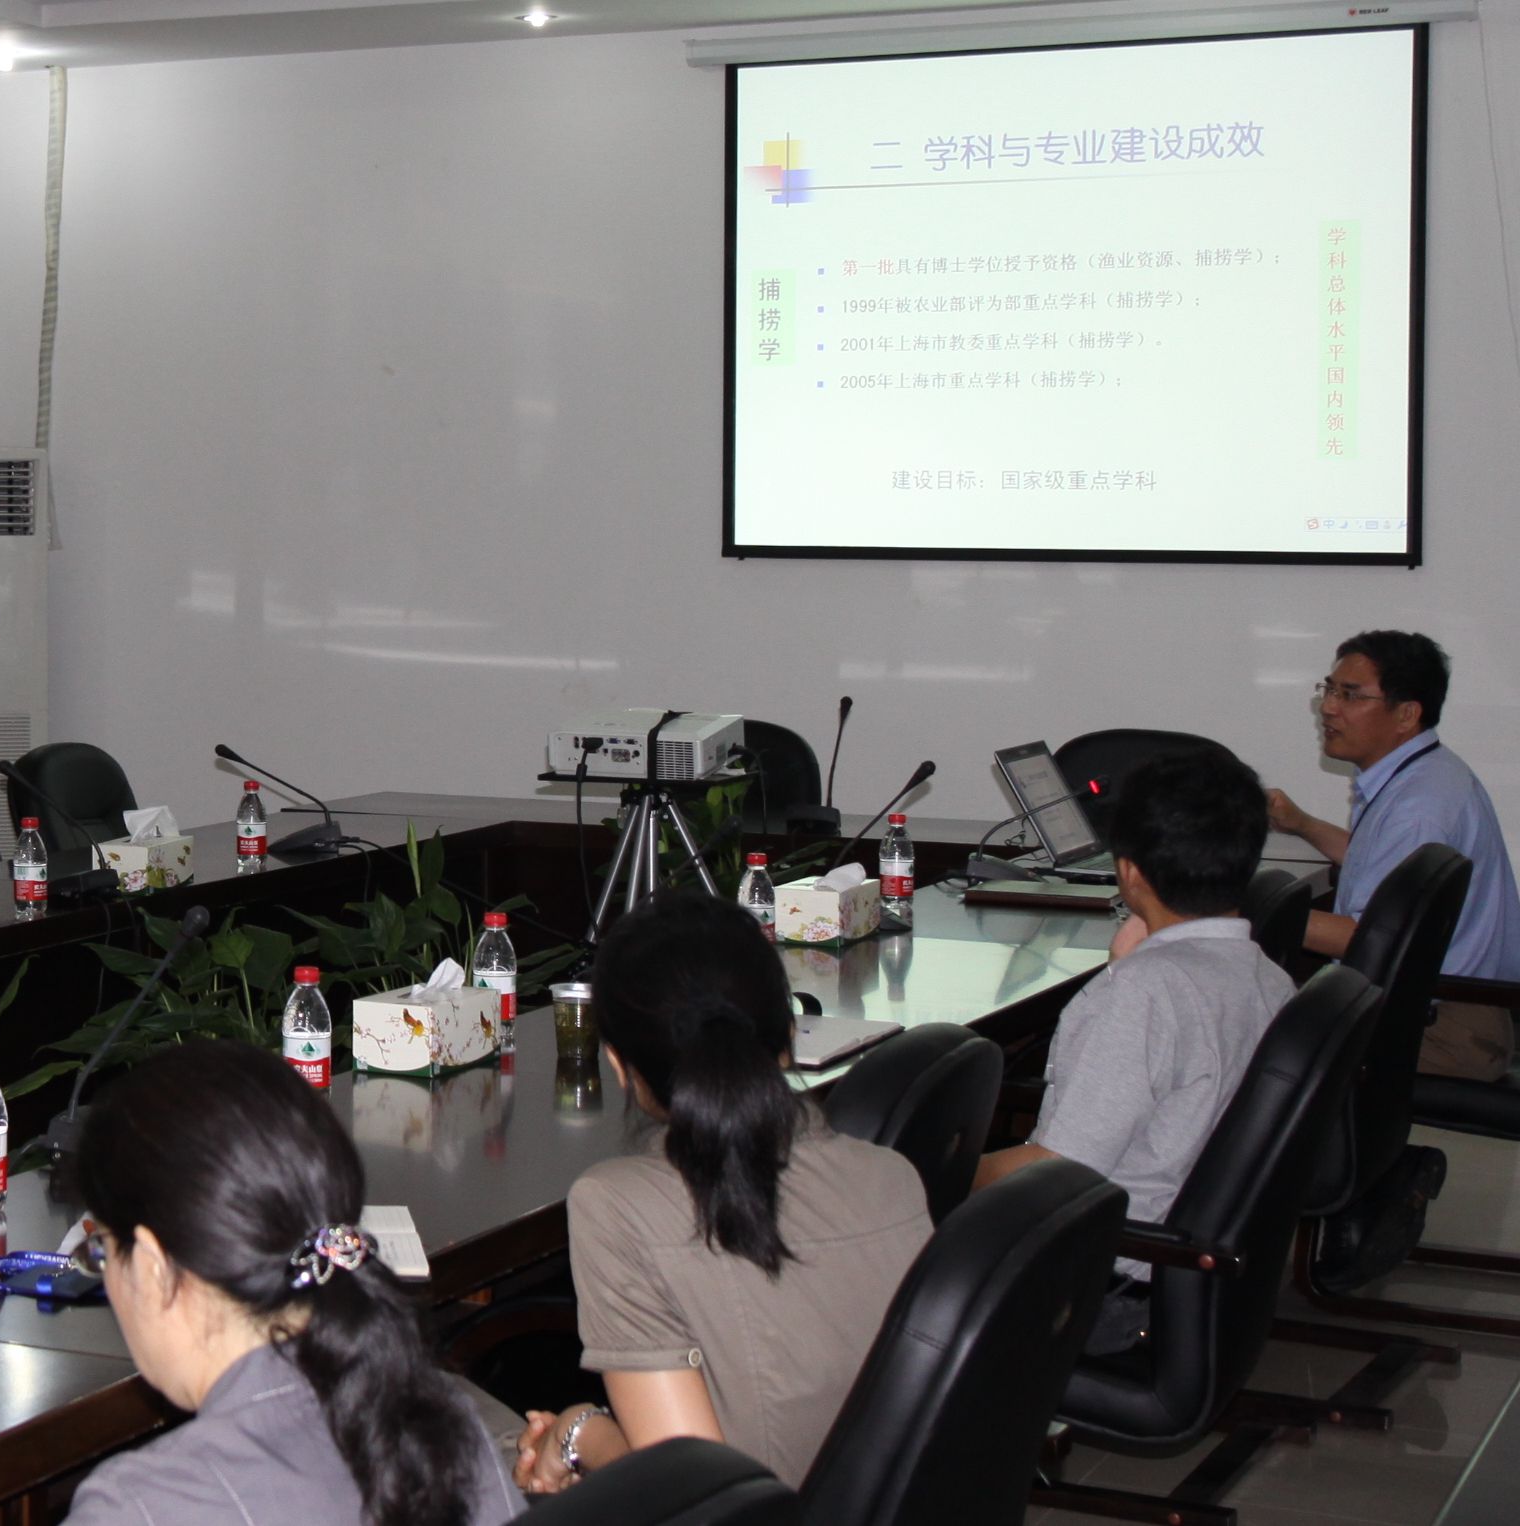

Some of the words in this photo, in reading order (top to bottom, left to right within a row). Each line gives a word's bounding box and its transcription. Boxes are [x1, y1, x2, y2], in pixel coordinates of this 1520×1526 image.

[869, 141, 903, 170] 二
[924, 120, 1266, 172] 学科与专业建设成效
[758, 277, 781, 361] 捕捞学
[1326, 227, 1348, 457] 学科总体水平国内领先
[891, 469, 1158, 491] 建设目标：国家级重点学科
